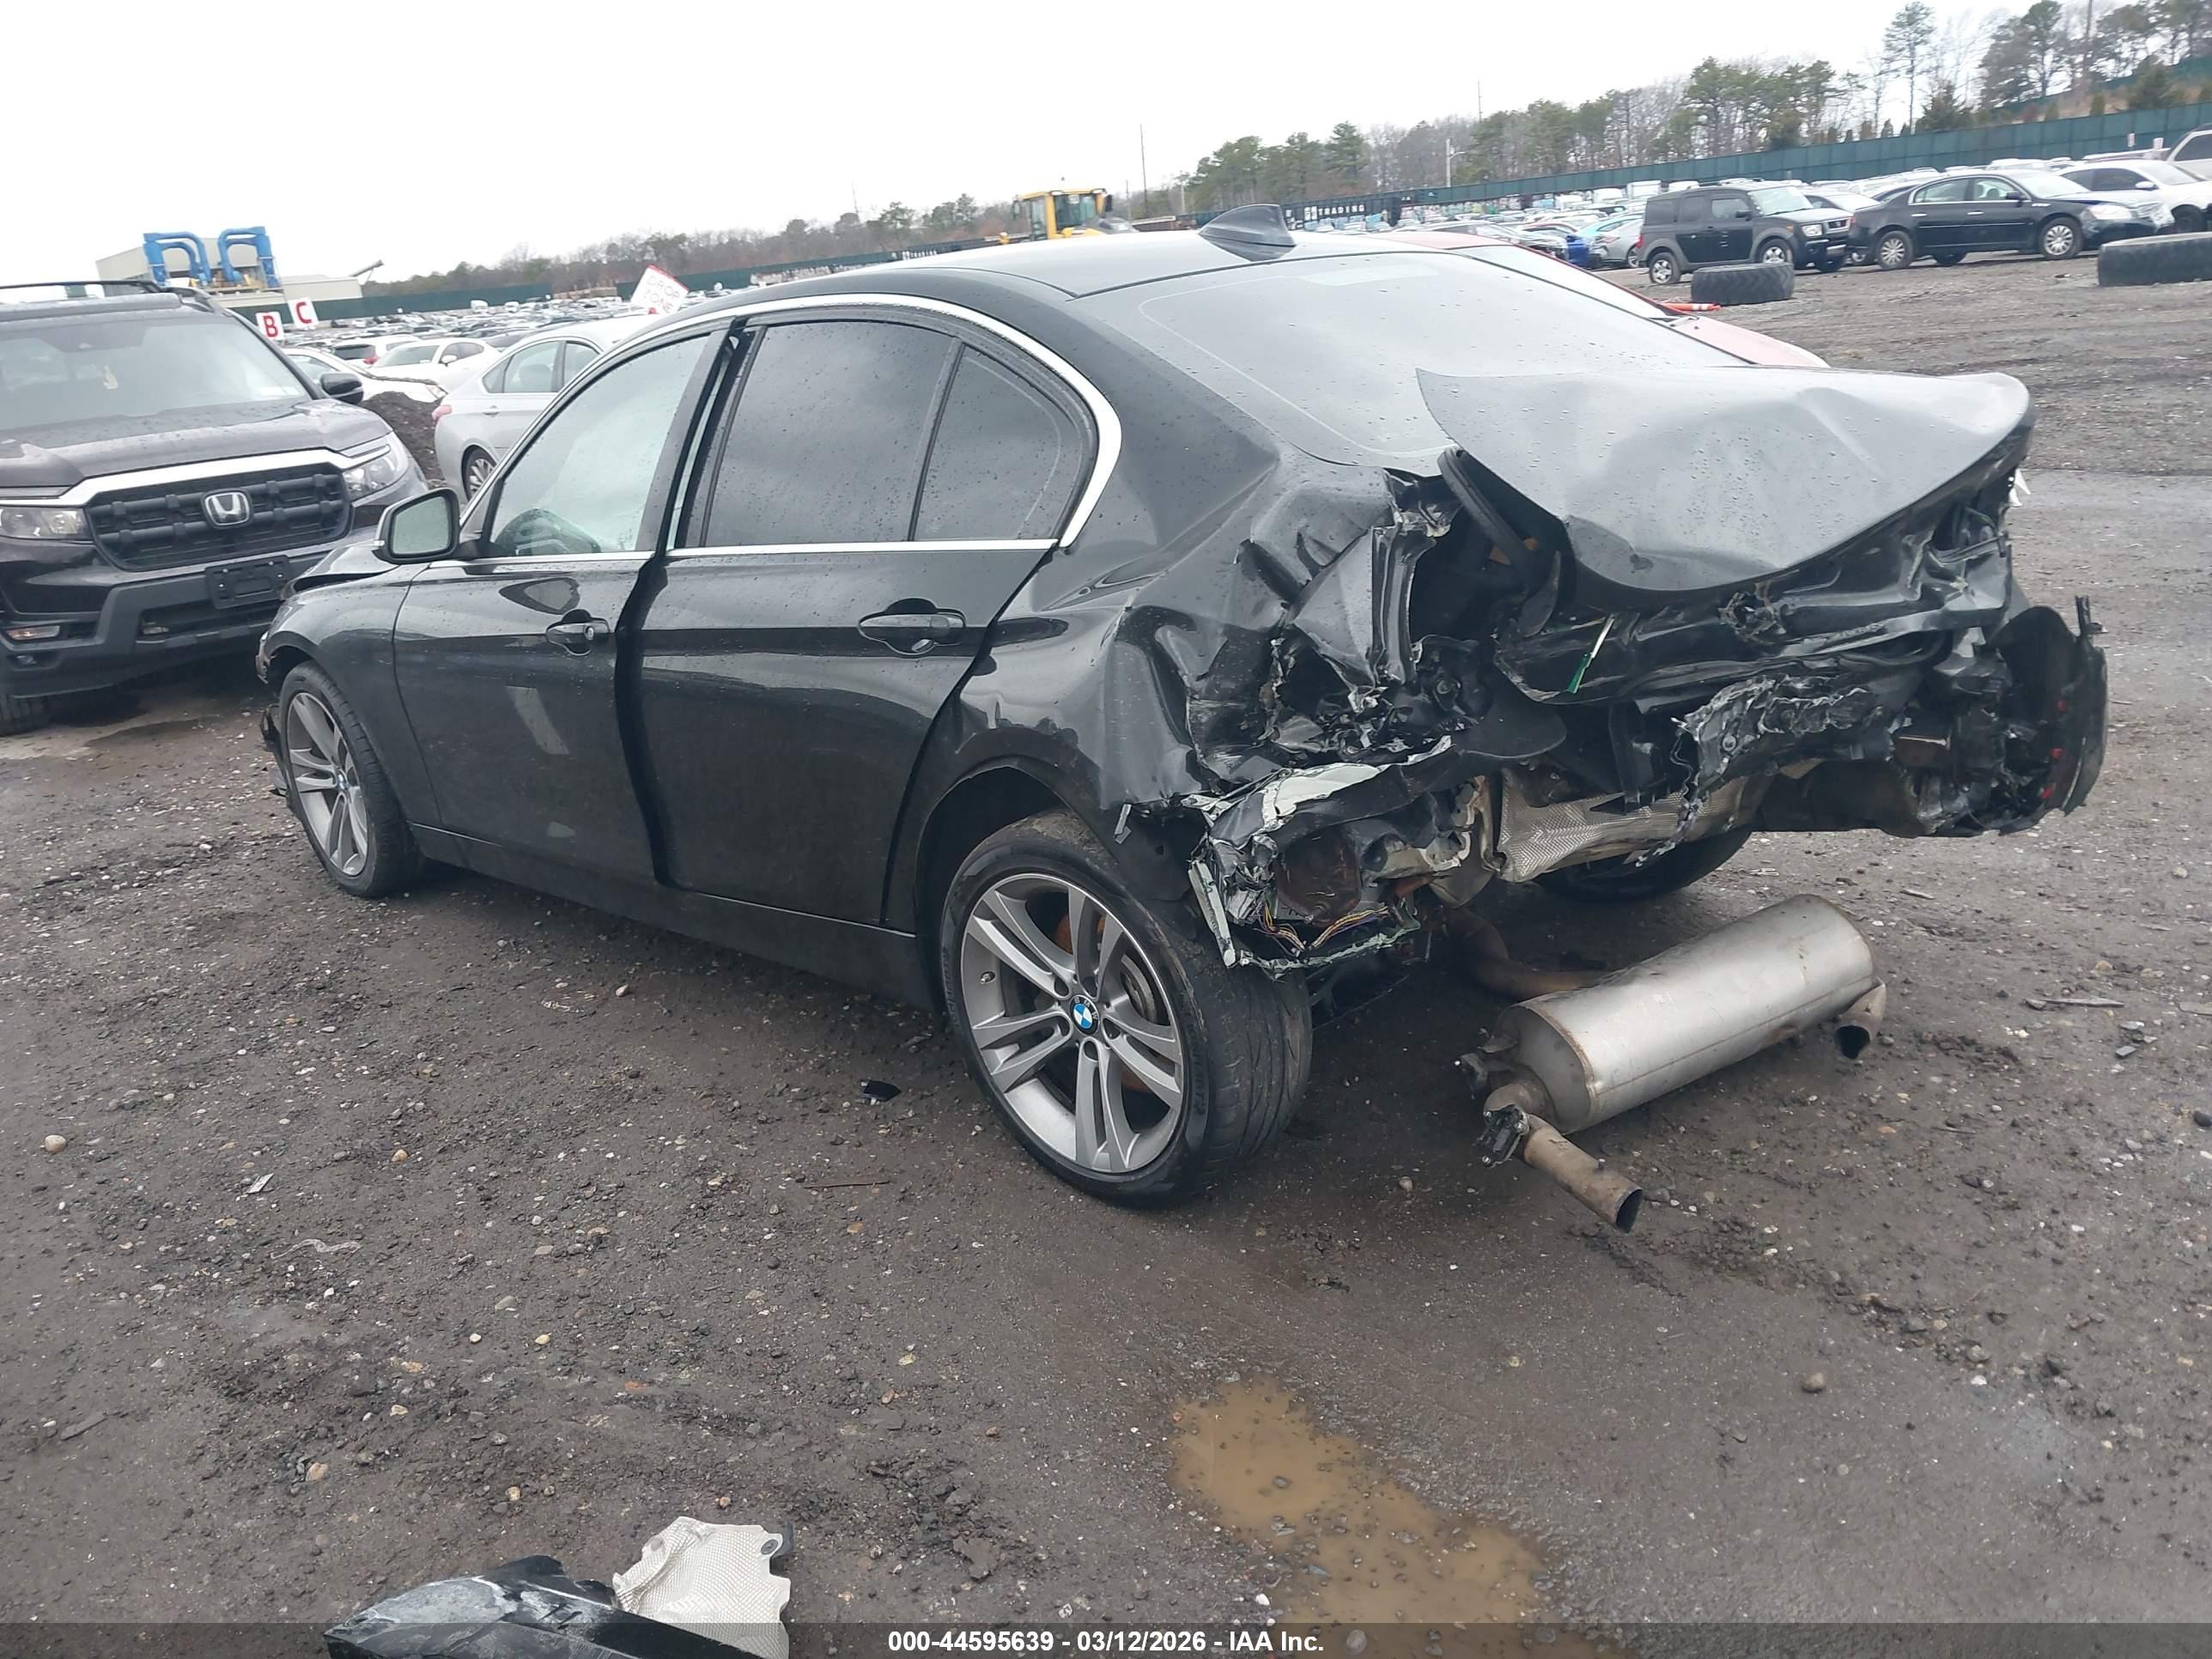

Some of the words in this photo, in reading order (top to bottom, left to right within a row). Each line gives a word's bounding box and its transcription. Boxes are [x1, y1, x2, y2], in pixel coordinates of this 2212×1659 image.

[1318, 204, 1364, 216] TRADING
[647, 275, 681, 300] DROP
[295, 301, 312, 324] C
[263, 315, 279, 338] B
[1074, 996, 1098, 1020] BMW
